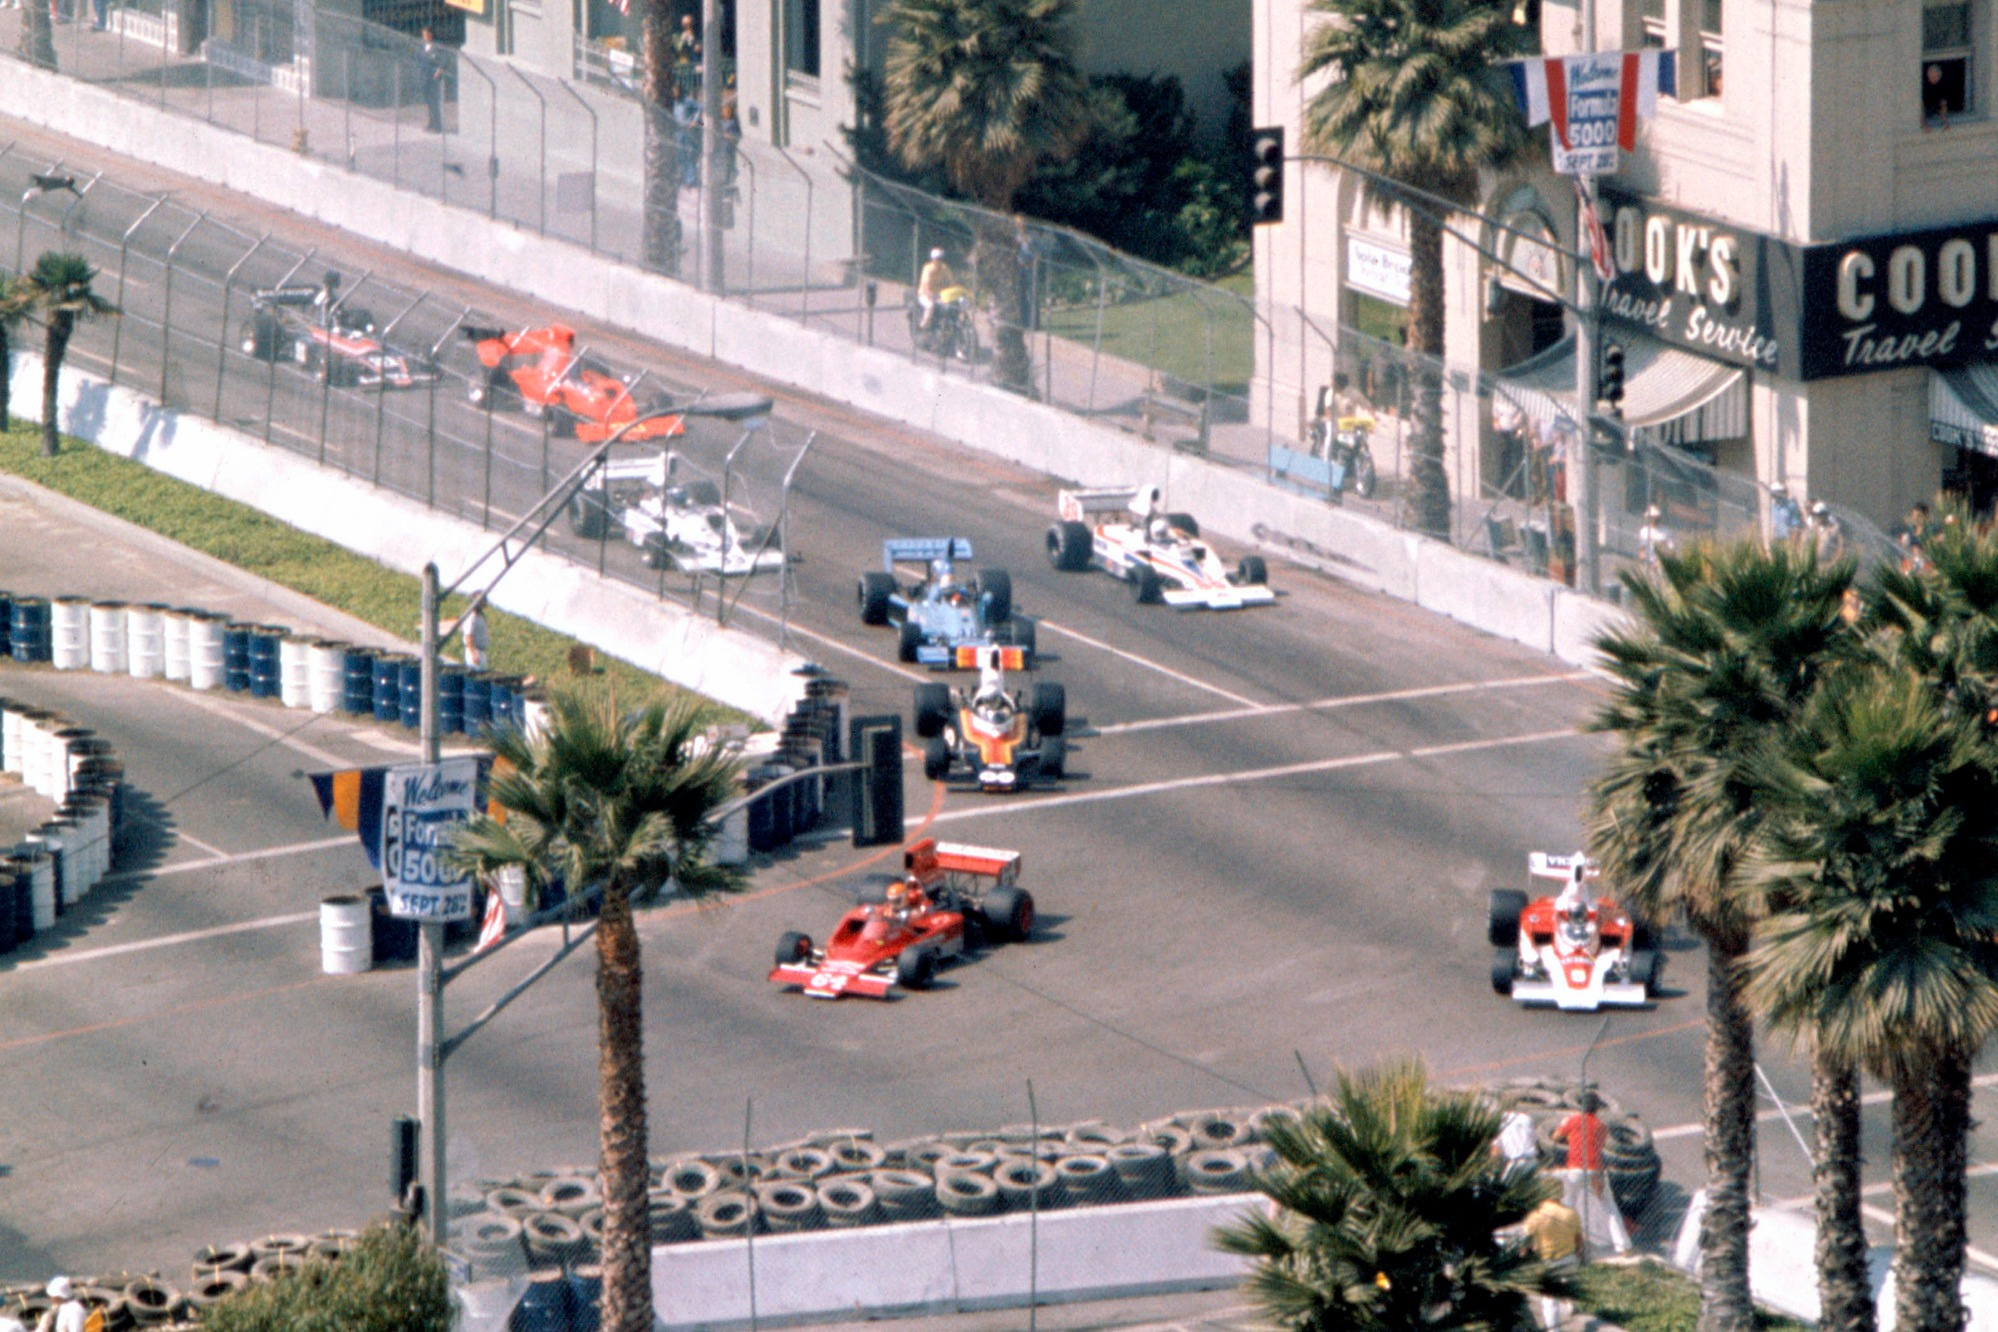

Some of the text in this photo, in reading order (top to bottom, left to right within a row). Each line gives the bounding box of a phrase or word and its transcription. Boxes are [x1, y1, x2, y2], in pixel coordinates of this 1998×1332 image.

[1570, 121, 1615, 146] 5000
[1604, 202, 1732, 304] OOK'S
[1685, 305, 1777, 364] Service
[1842, 320, 1961, 366] Travel
[404, 850, 461, 884] 500
[401, 895, 440, 917] SEPT
[810, 973, 848, 991] 64
